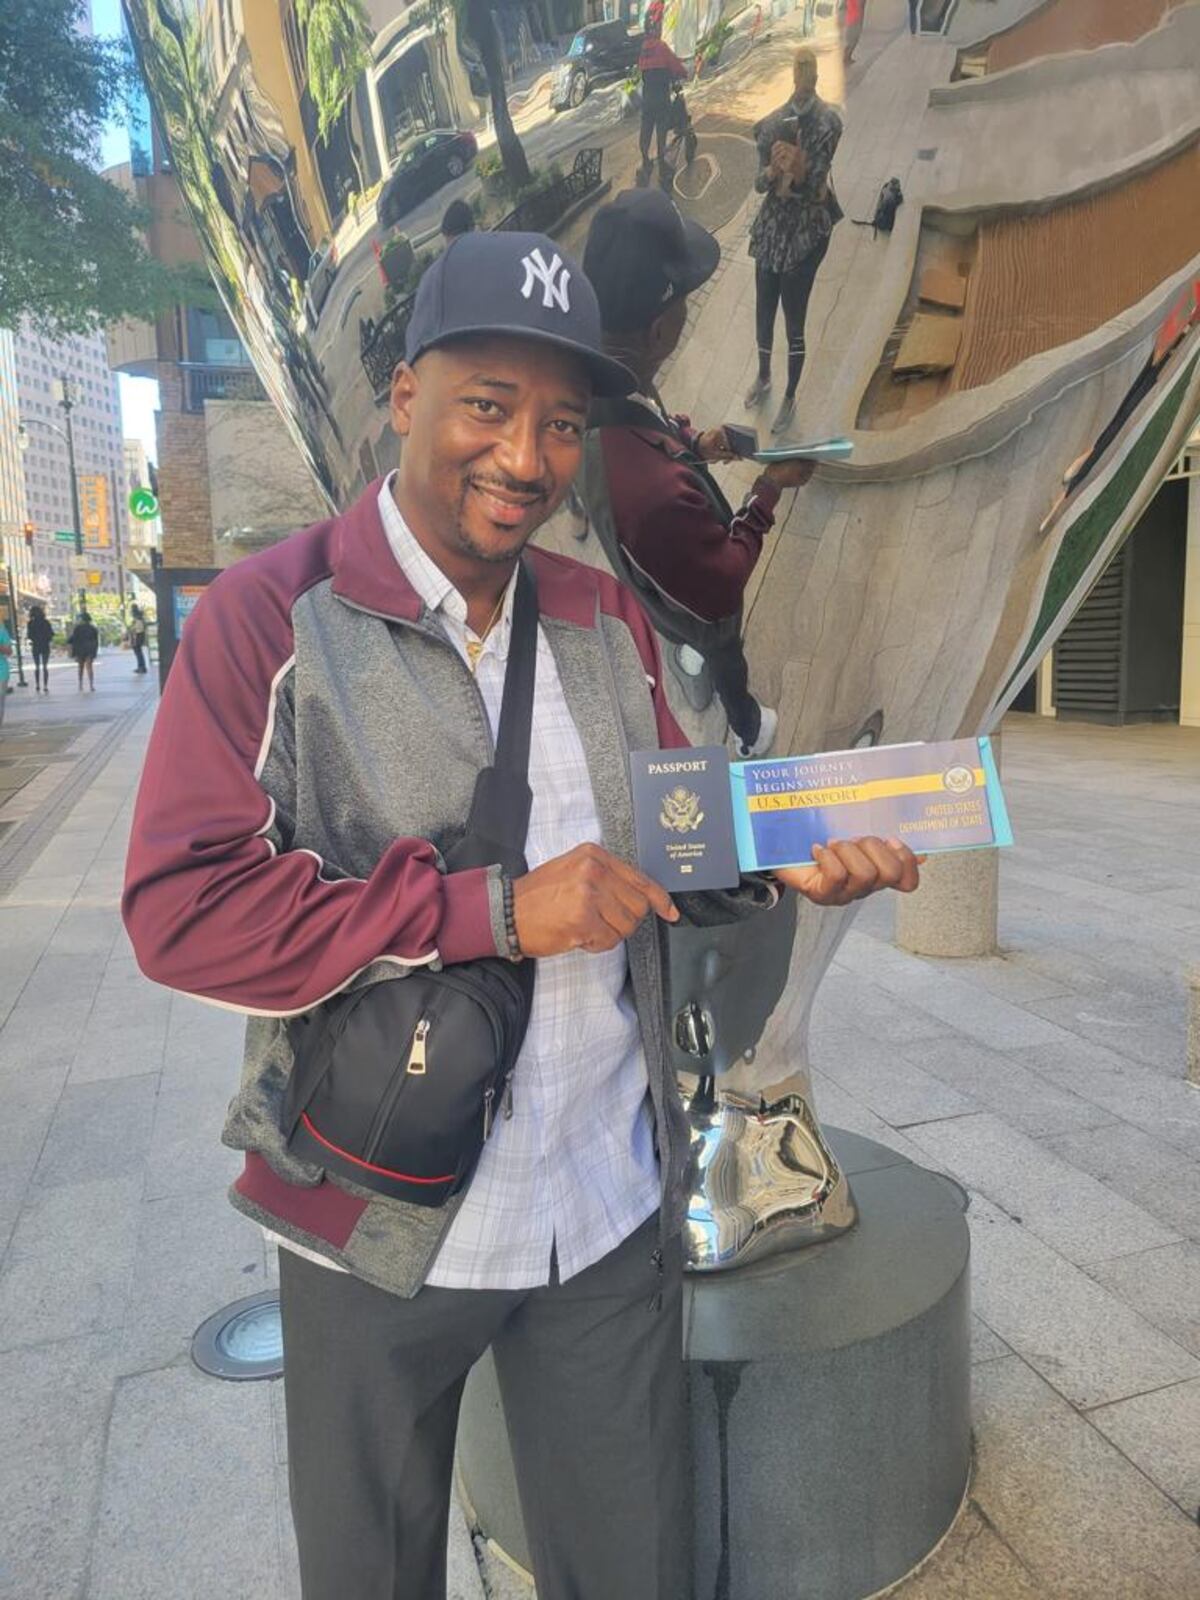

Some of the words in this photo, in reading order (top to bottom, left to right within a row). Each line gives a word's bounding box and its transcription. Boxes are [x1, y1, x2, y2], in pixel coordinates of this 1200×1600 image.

[647, 760, 707, 775] PASSPORT
[752, 768, 789, 780] YOUR
[794, 760, 854, 778] JOURNEY
[755, 780, 801, 793] BEGINS
[806, 776, 843, 788] WITH
[849, 774, 859, 785] A
[757, 797, 785, 809] U.S.
[789, 788, 860, 807] PASSPORT
